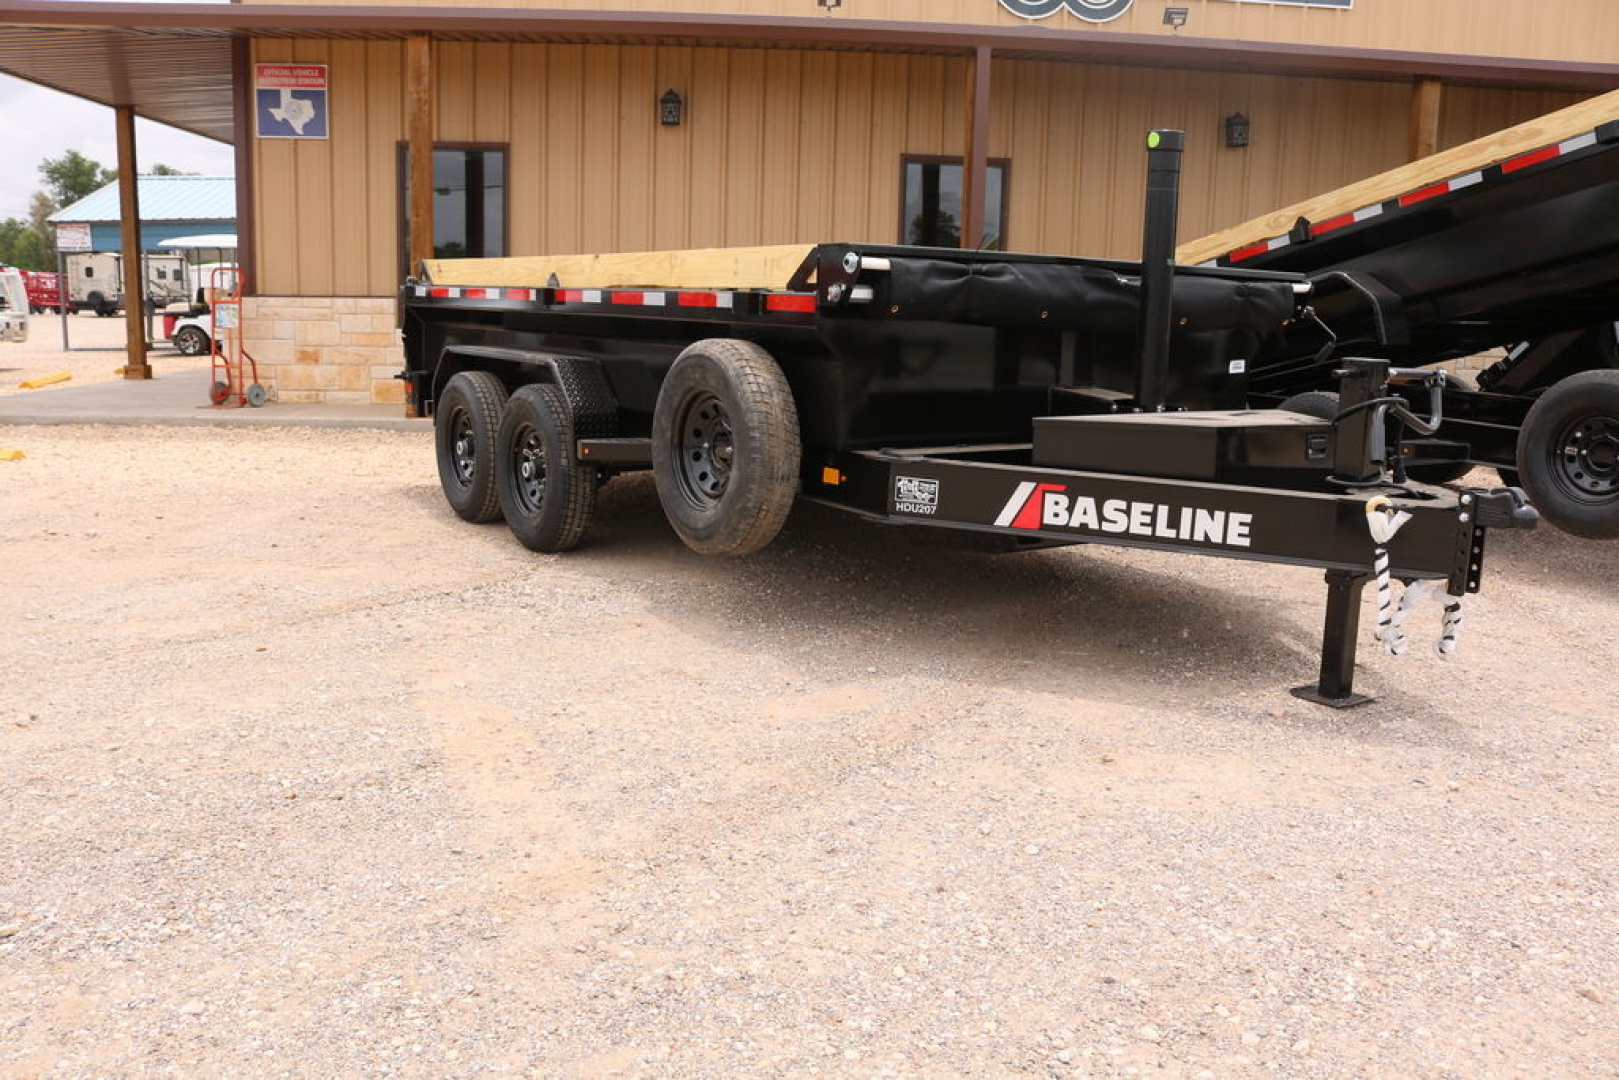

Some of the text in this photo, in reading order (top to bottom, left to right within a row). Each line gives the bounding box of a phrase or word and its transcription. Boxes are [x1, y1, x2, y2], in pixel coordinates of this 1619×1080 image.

[263, 68, 319, 77] OFFICIAL VEHICLE
[298, 77, 325, 85] STATION
[895, 502, 937, 515] HDU207
[1042, 492, 1253, 548] BASELINE
